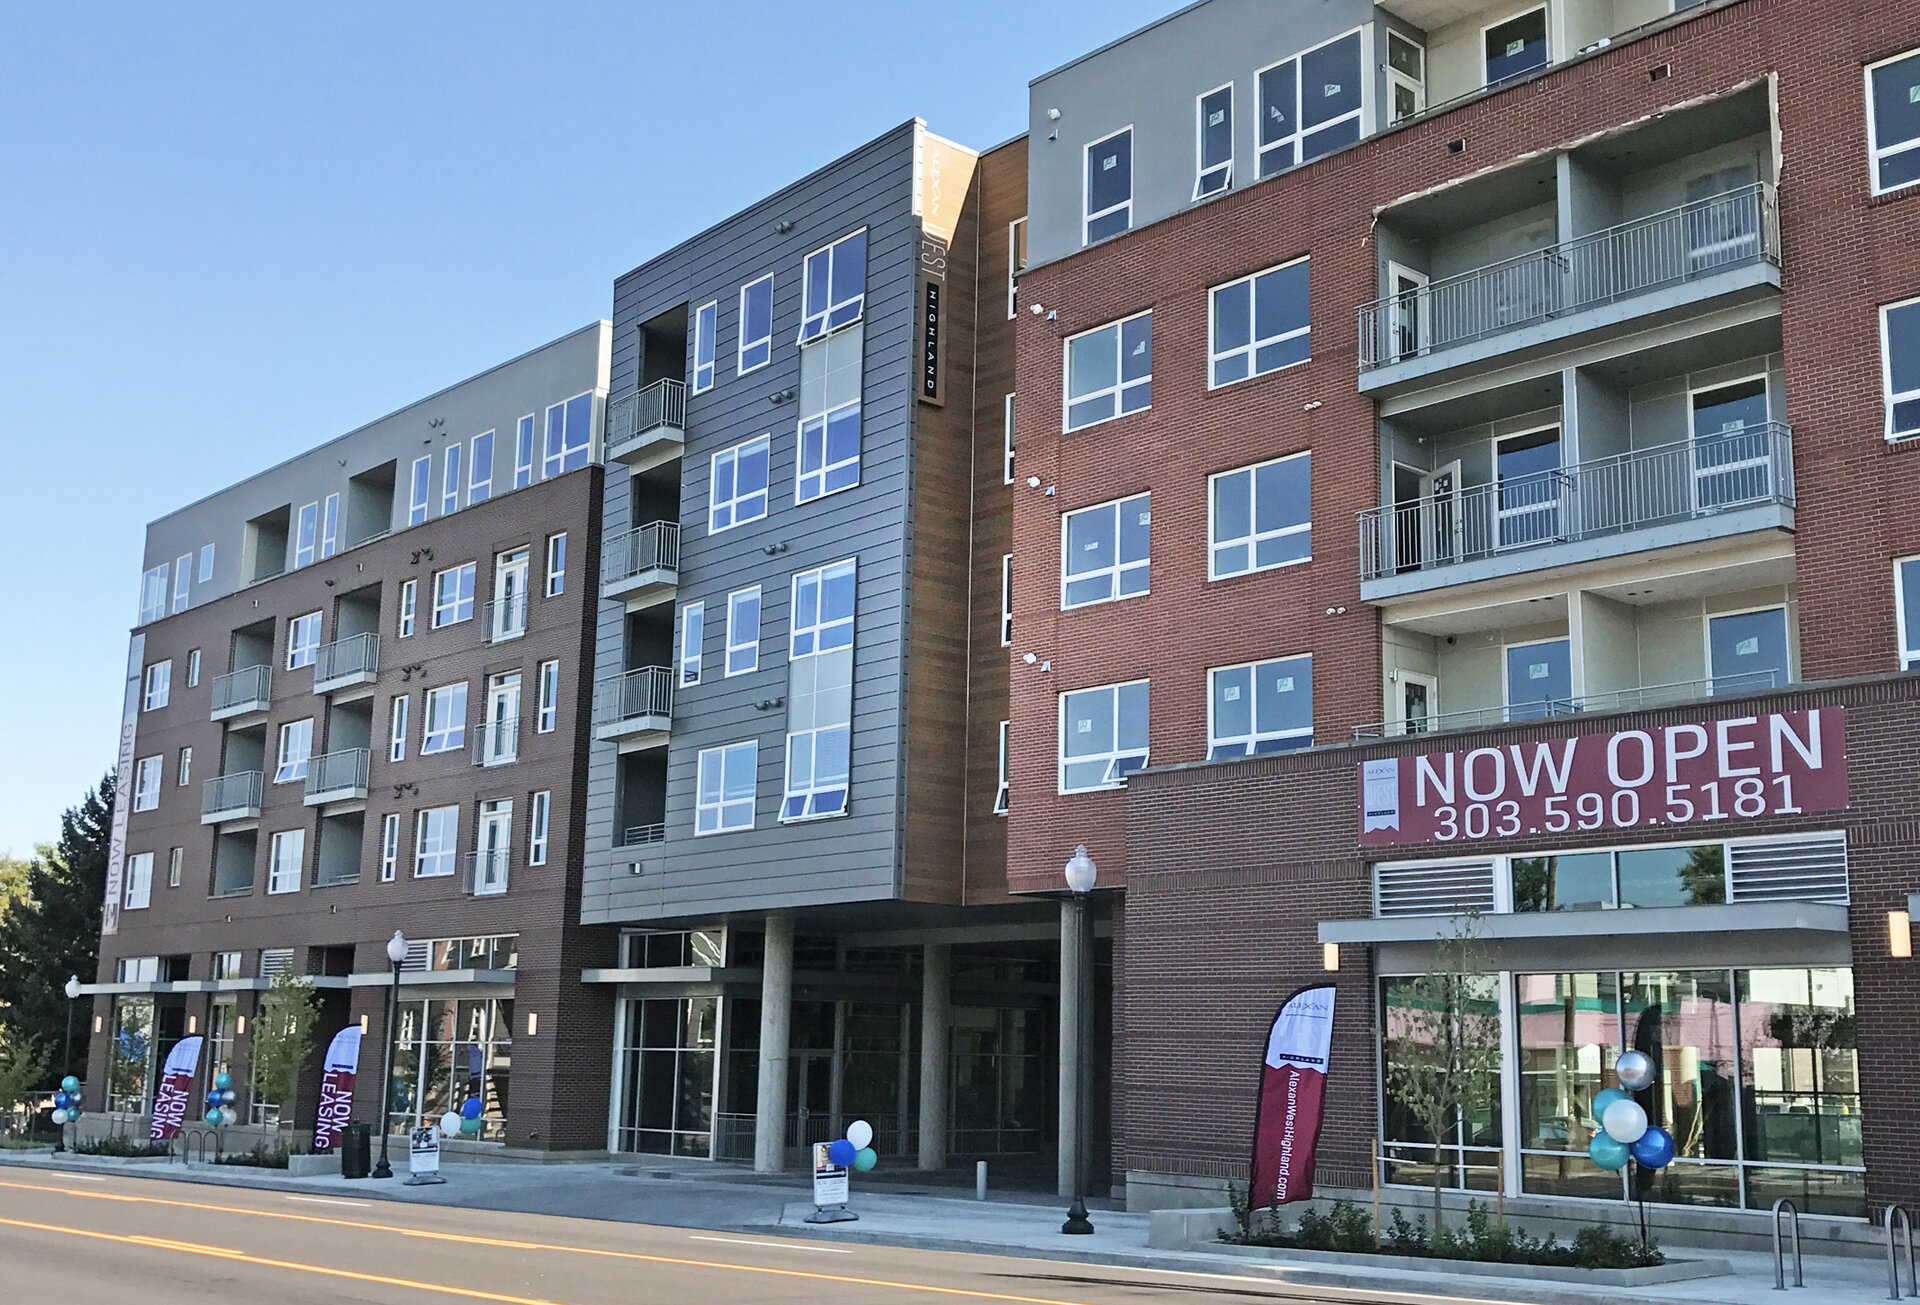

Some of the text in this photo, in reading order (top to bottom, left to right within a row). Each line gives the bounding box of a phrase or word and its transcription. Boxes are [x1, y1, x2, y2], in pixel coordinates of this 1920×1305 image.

[929, 148, 942, 216] ALEXAN
[921, 221, 946, 281] WEST
[926, 290, 937, 390] HIGHLAND
[115, 723, 133, 828] LEASING
[1367, 767, 1395, 775] ALEXAN
[1416, 709, 1823, 807] NOW OPEN
[1433, 774, 1802, 842] 303.590.5181
[107, 836, 125, 897] NOW
[150, 1074, 177, 1139] LEASING
[169, 1090, 190, 1127] NOW
[314, 1073, 338, 1149] LEASING
[332, 1090, 353, 1132] NOW
[1276, 1070, 1301, 1200] AlexanWestHighland.com
